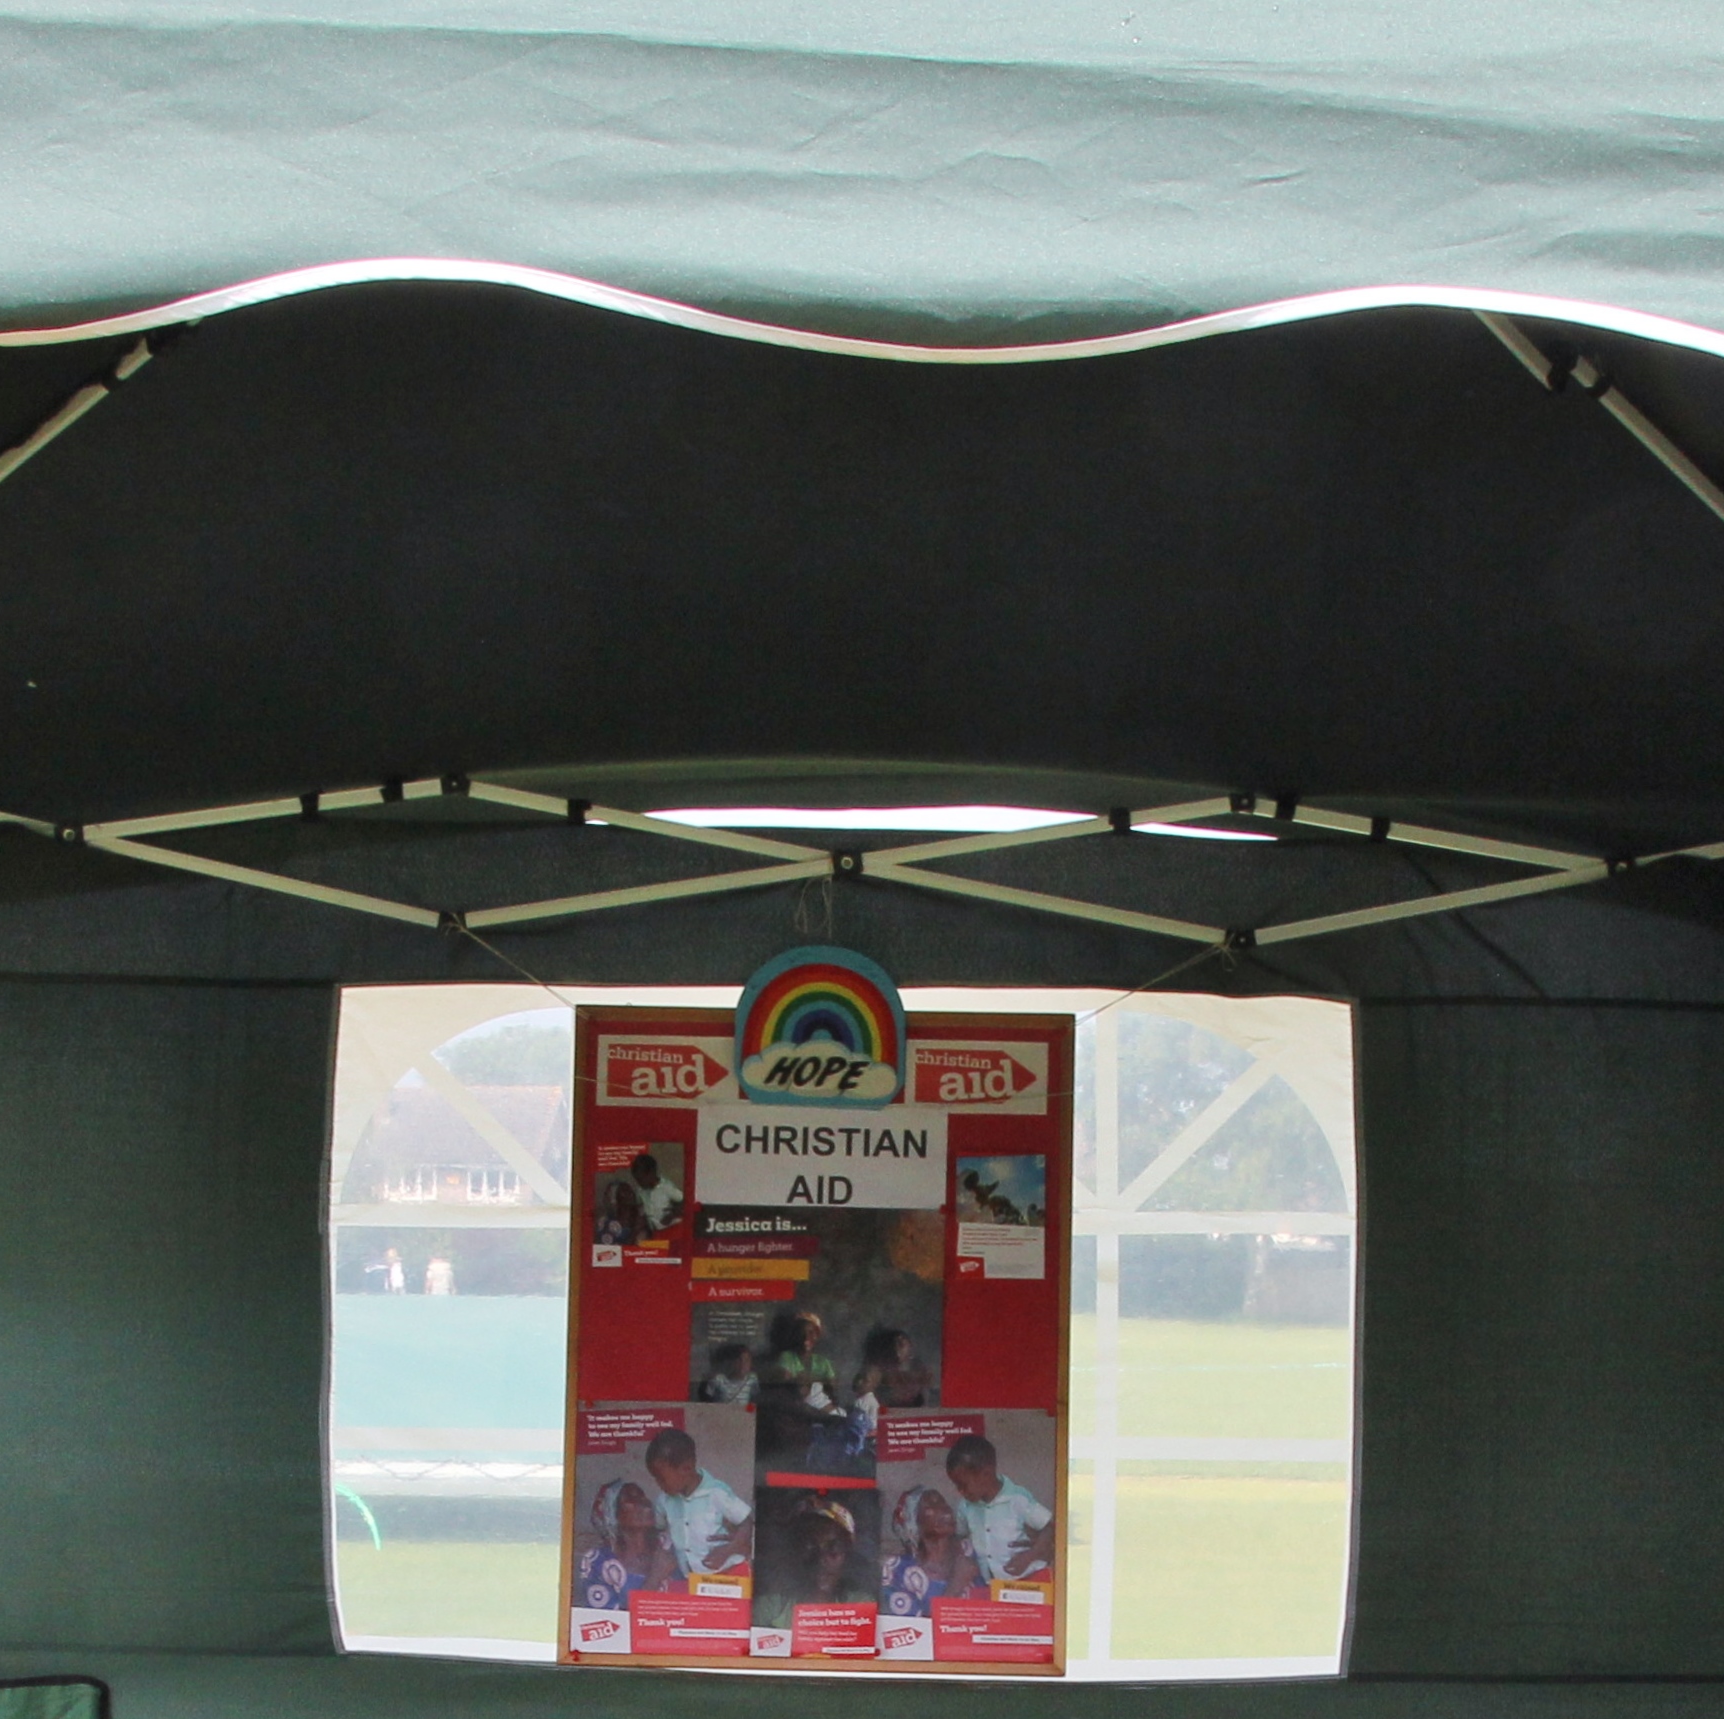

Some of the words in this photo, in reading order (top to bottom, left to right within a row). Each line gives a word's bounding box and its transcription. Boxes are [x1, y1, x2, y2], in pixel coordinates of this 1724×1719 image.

[607, 1045, 684, 1065] christian
[915, 1048, 993, 1070] christian
[631, 1054, 708, 1097] aid
[764, 1055, 872, 1090] HOPE
[939, 1059, 1017, 1103] aid
[715, 1123, 929, 1159] CHRISTIAN
[786, 1174, 854, 1205] AID
[706, 1217, 772, 1233] Jessica
[718, 1242, 756, 1255] hunger
[708, 1287, 718, 1297] A
[588, 1621, 615, 1641] aid
[637, 1617, 666, 1627] Thank
[939, 1624, 968, 1634] Thank
[891, 1628, 918, 1649] aid
